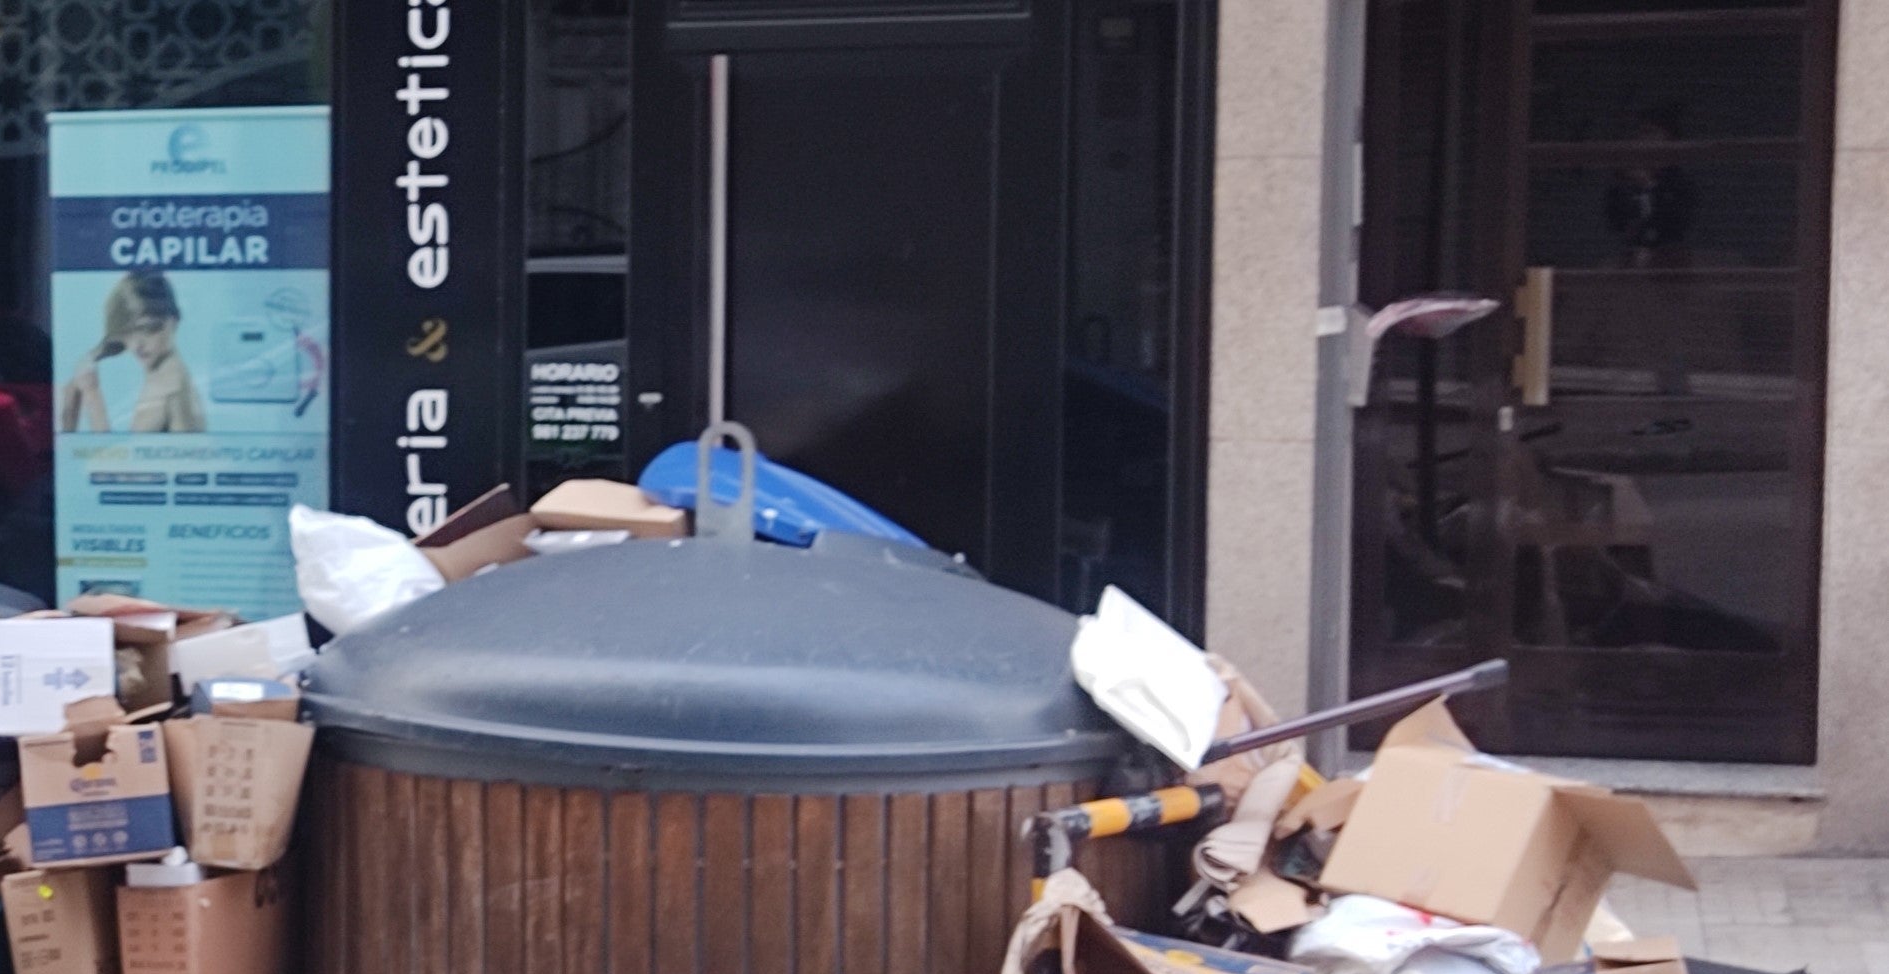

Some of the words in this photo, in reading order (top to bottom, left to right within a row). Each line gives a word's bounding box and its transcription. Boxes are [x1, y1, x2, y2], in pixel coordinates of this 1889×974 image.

[397, 0, 451, 289] estetic
[110, 199, 270, 234] crioterapia
[110, 235, 270, 266] CAPILAR
[408, 318, 449, 362] &
[531, 363, 620, 382] HORARIO
[167, 524, 272, 541] BENEFICIOS
